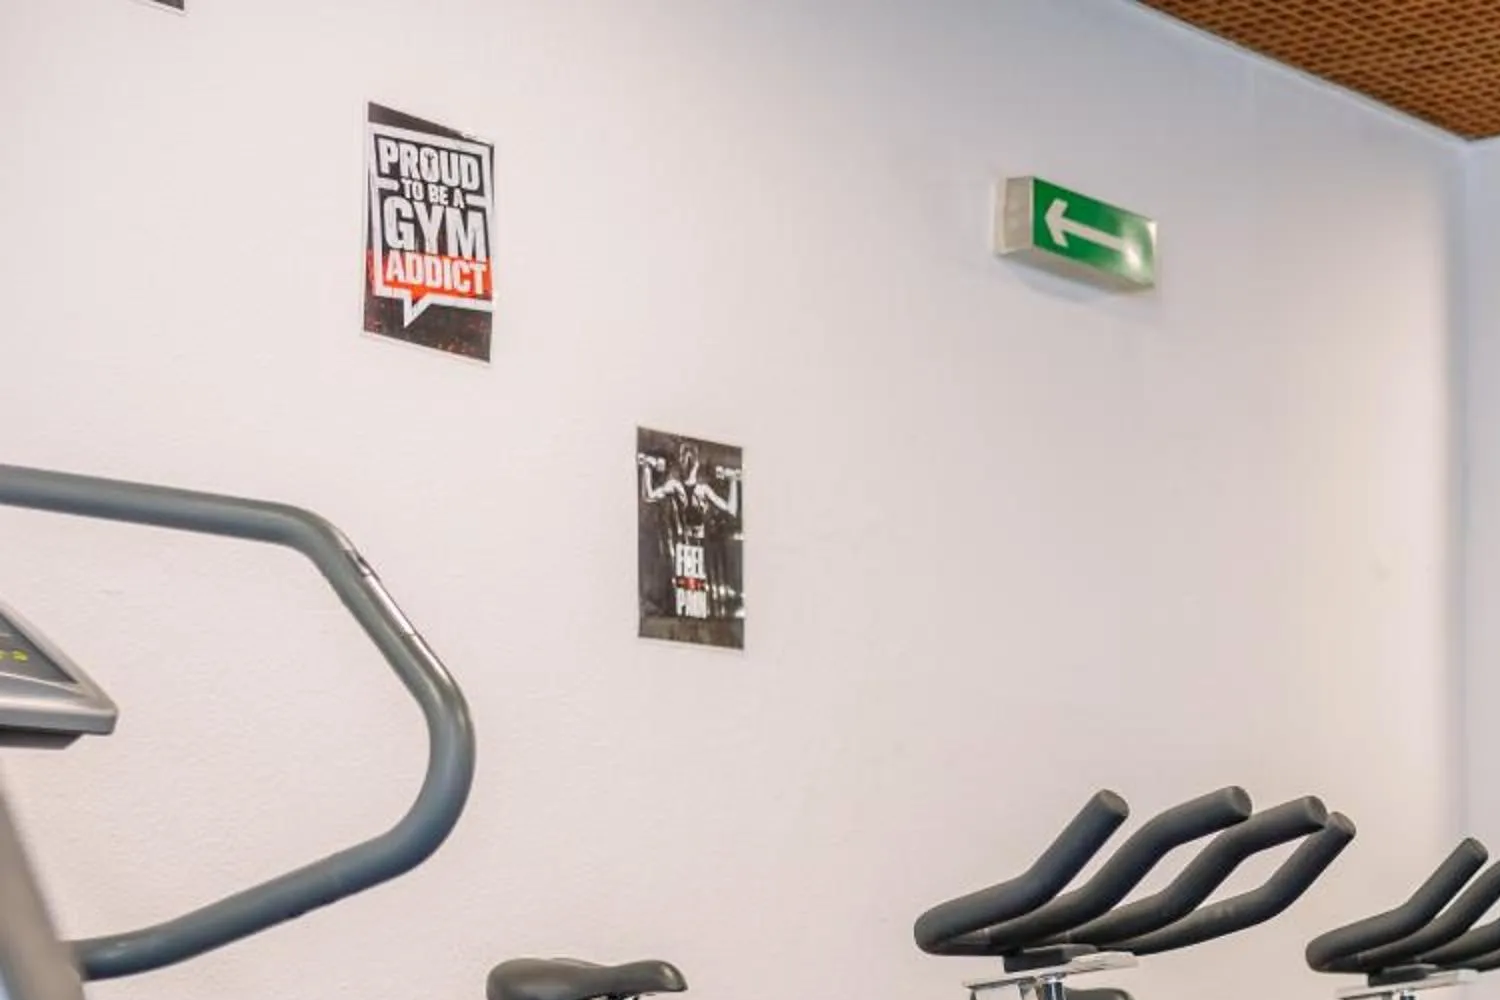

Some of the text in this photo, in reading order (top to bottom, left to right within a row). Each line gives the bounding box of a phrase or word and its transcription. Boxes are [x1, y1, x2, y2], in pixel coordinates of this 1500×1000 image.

[377, 138, 480, 191] PROUD
[401, 178, 465, 209] TO BE A
[383, 195, 486, 264] GYM
[386, 249, 488, 295] ADDICT
